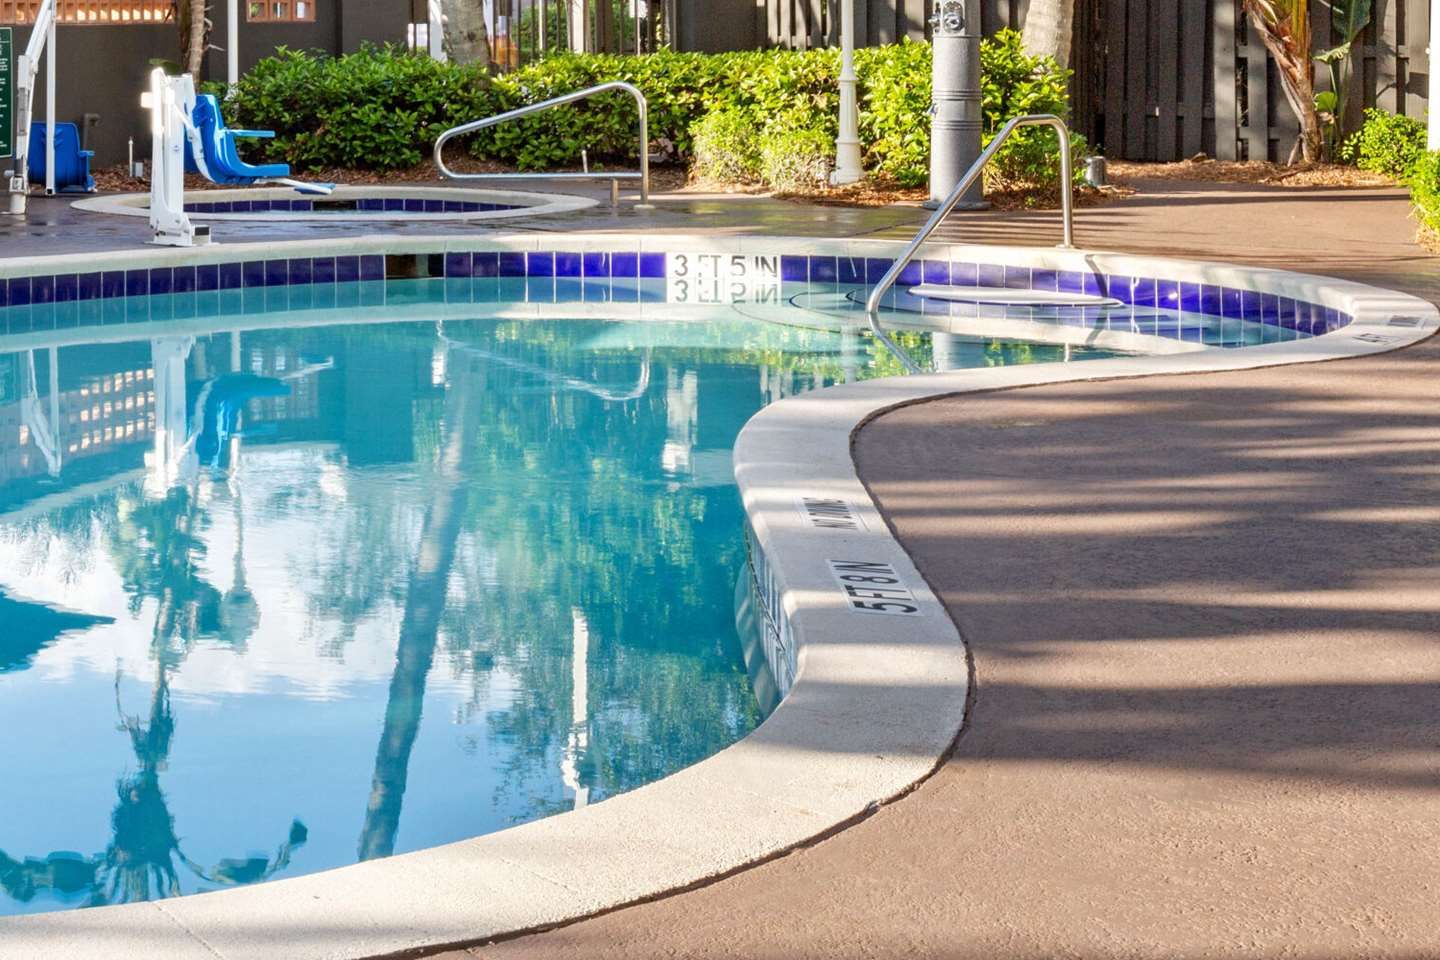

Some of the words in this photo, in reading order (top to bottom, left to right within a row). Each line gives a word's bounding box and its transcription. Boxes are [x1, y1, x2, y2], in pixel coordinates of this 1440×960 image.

[674, 254, 688, 277] 3
[731, 256, 746, 277] 5
[755, 256, 777, 278] IN
[830, 559, 896, 575] IN
[840, 575, 899, 584] 8
[844, 584, 912, 601] FT
[853, 600, 918, 614] 5
